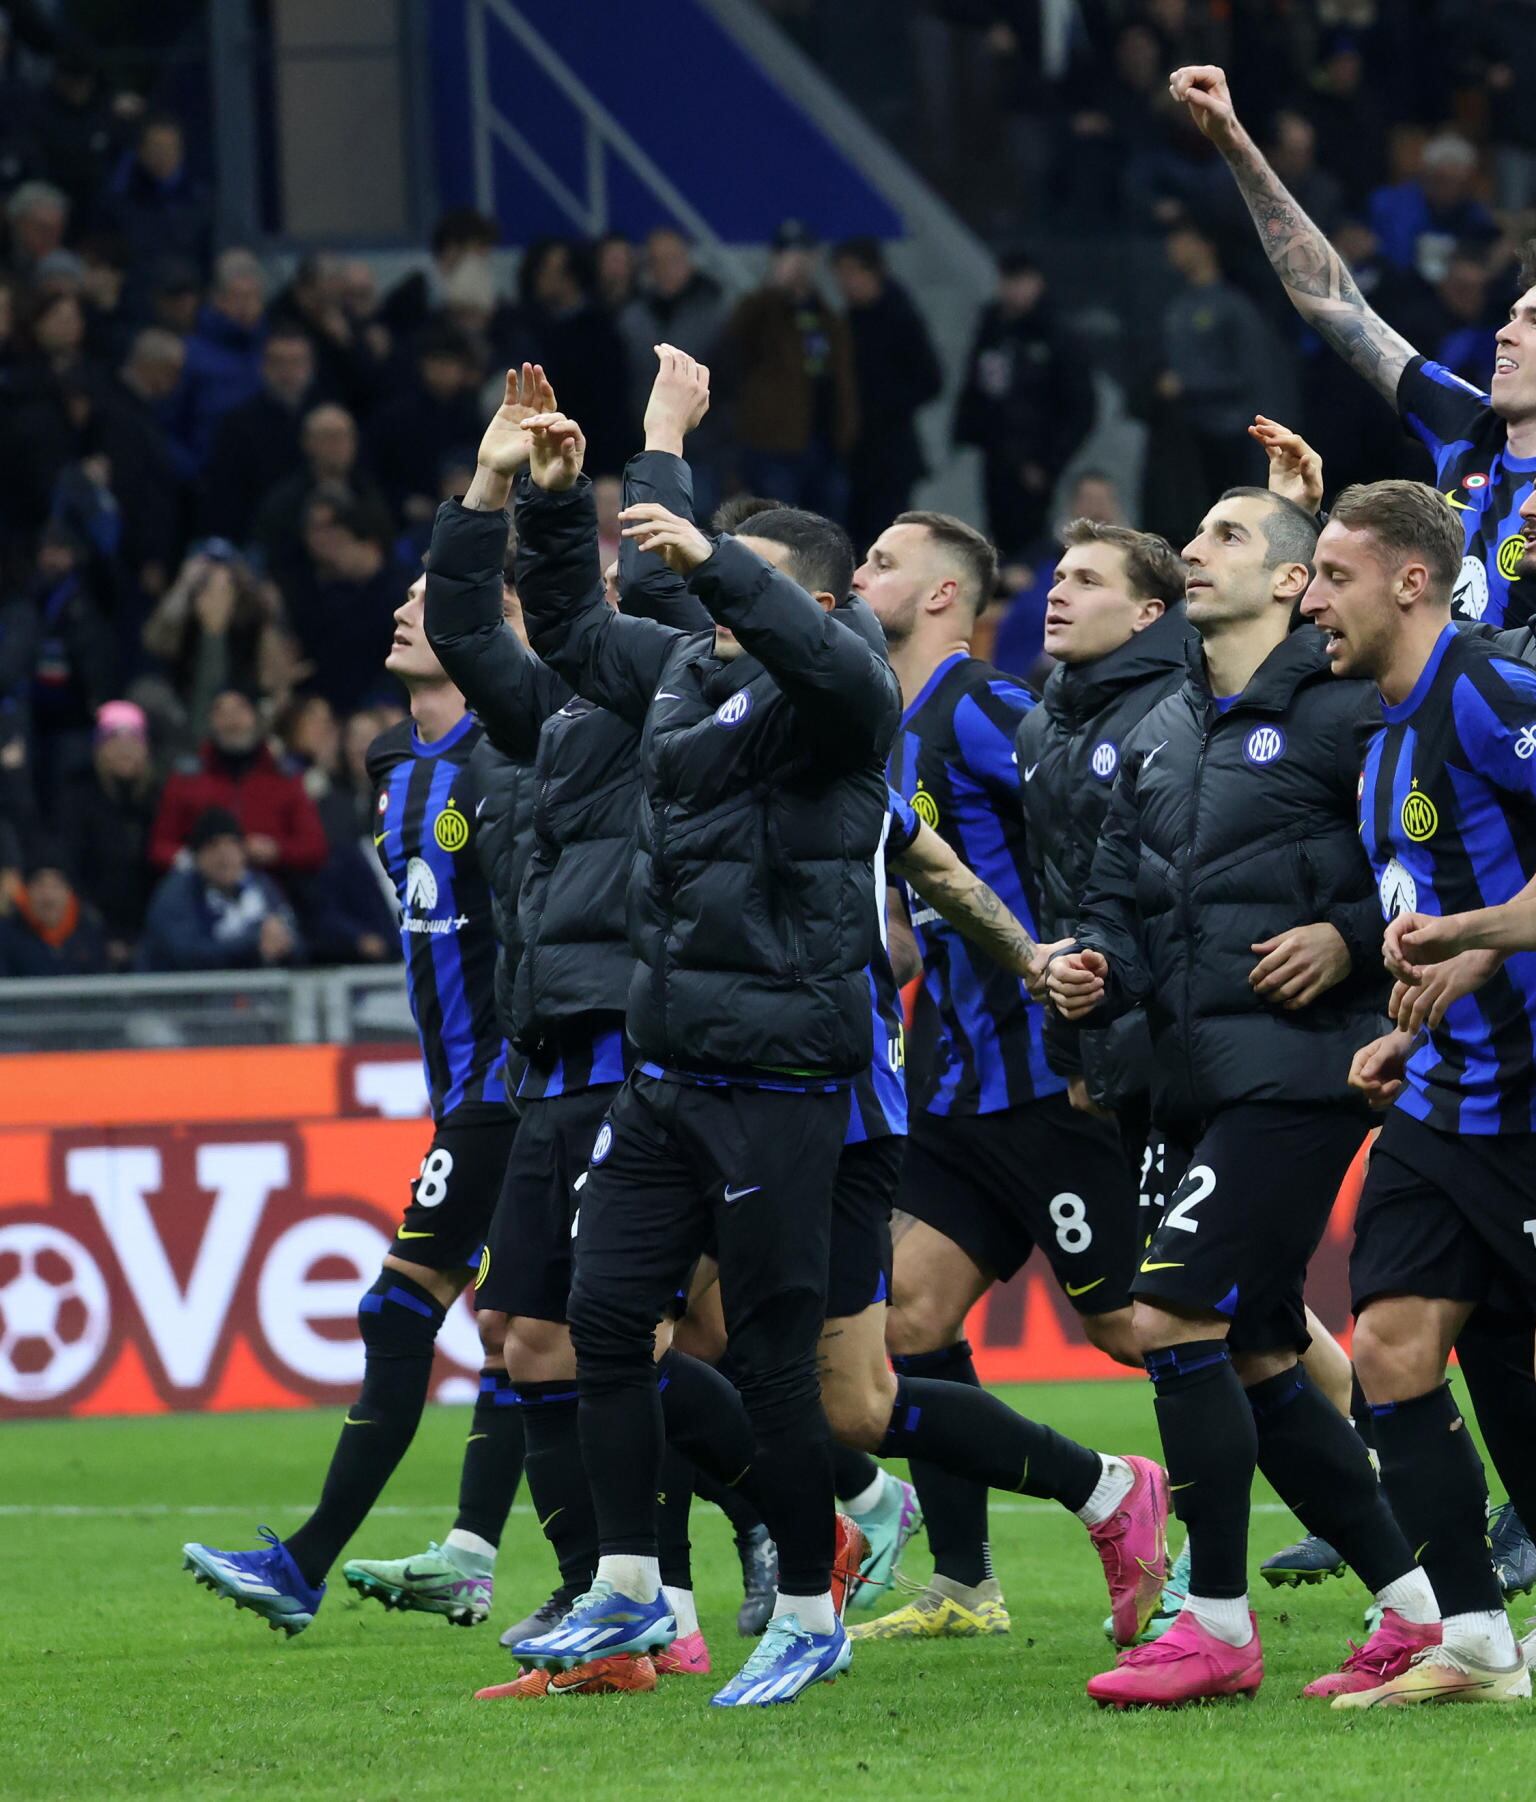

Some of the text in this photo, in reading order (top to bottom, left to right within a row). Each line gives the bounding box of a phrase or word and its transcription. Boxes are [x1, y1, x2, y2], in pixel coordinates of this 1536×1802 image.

[410, 1148, 454, 1208] 8
[1157, 1164, 1217, 1233] 2
[1048, 1192, 1093, 1254] 8
